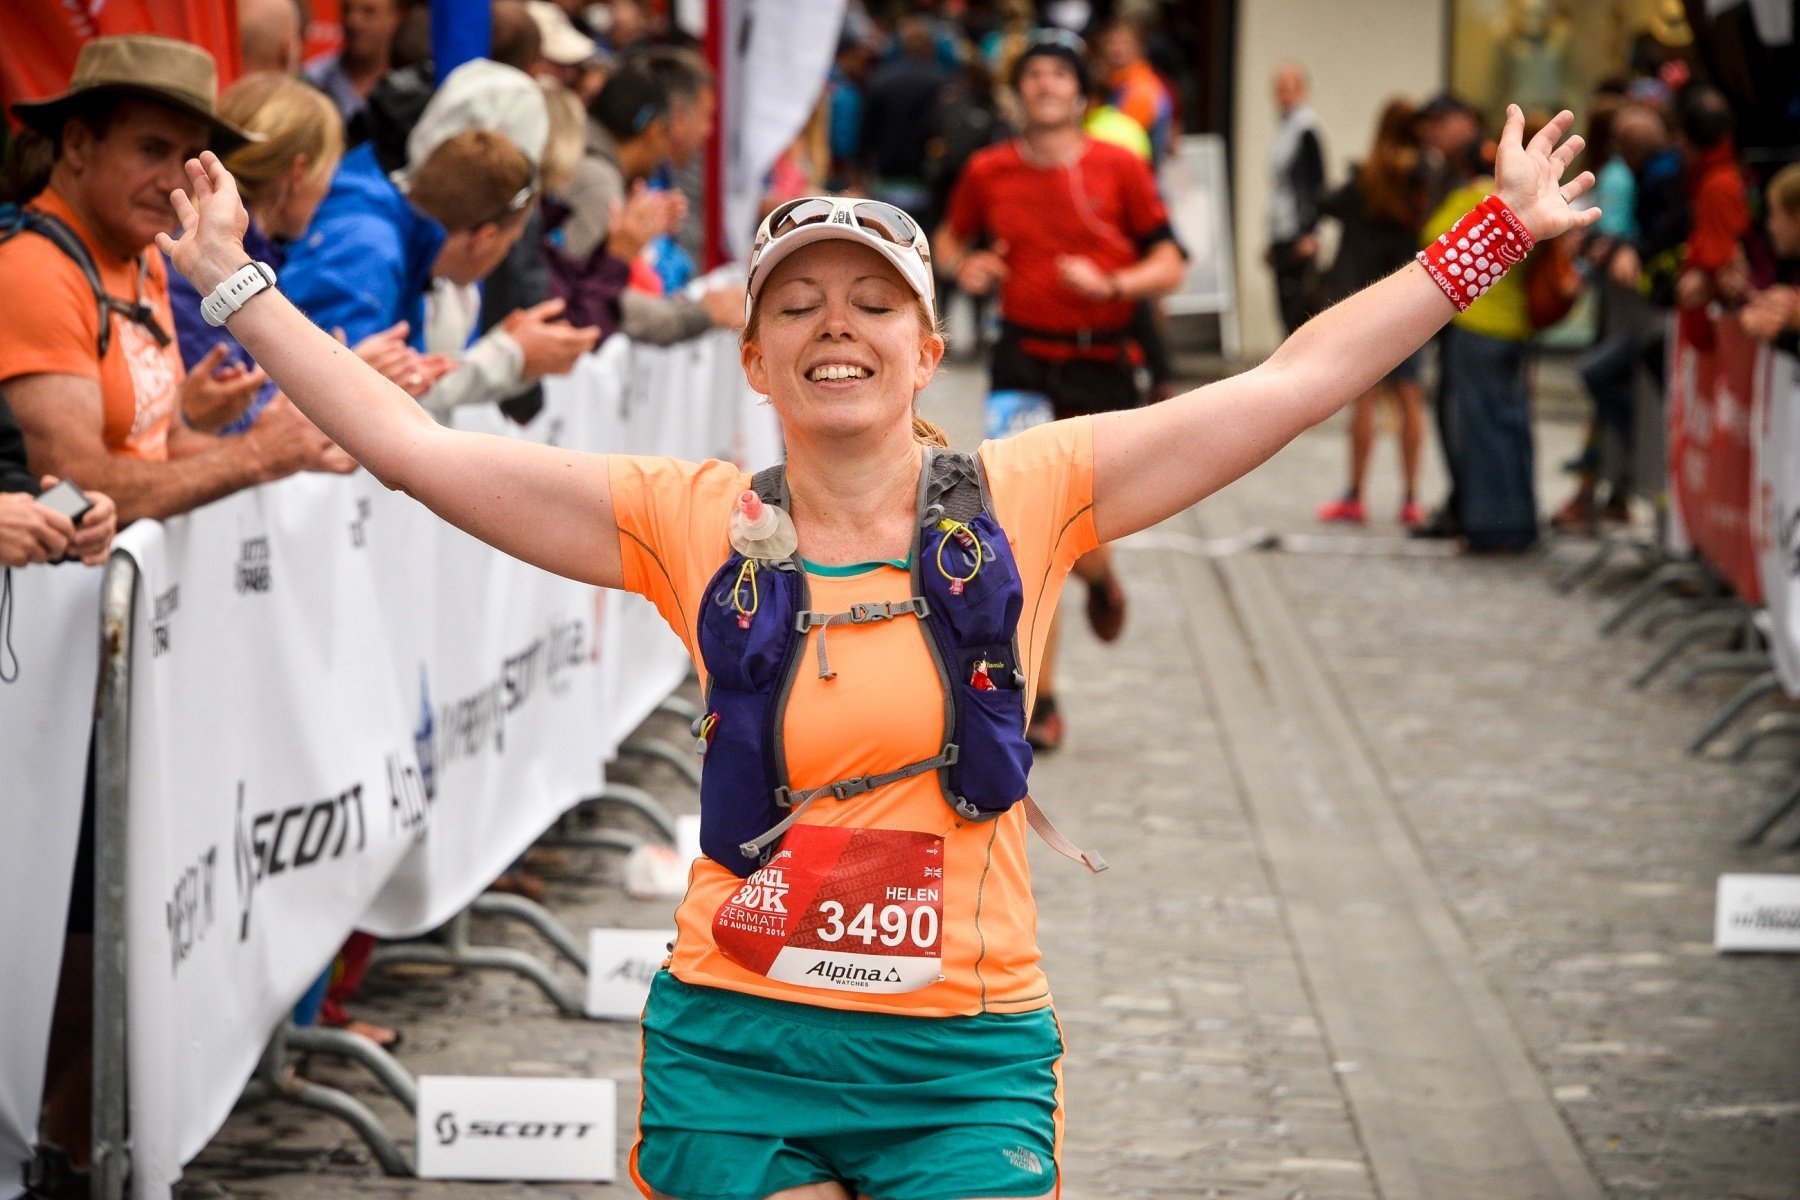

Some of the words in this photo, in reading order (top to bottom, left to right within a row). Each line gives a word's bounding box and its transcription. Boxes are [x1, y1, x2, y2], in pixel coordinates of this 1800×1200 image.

[253, 782, 366, 884] SCOTT
[731, 884, 789, 914] 30K
[885, 886, 939, 902] HELEN
[718, 918, 728, 927] 20
[730, 922, 763, 933] AUGUST
[765, 928, 786, 937] 2016
[720, 906, 787, 929] ZERMATT
[816, 900, 939, 948] 3490
[805, 960, 882, 982] Alpina
[835, 979, 869, 988] WATCHES
[466, 1121, 595, 1139] SCOTT
[1002, 1148, 1030, 1163] NORTH
